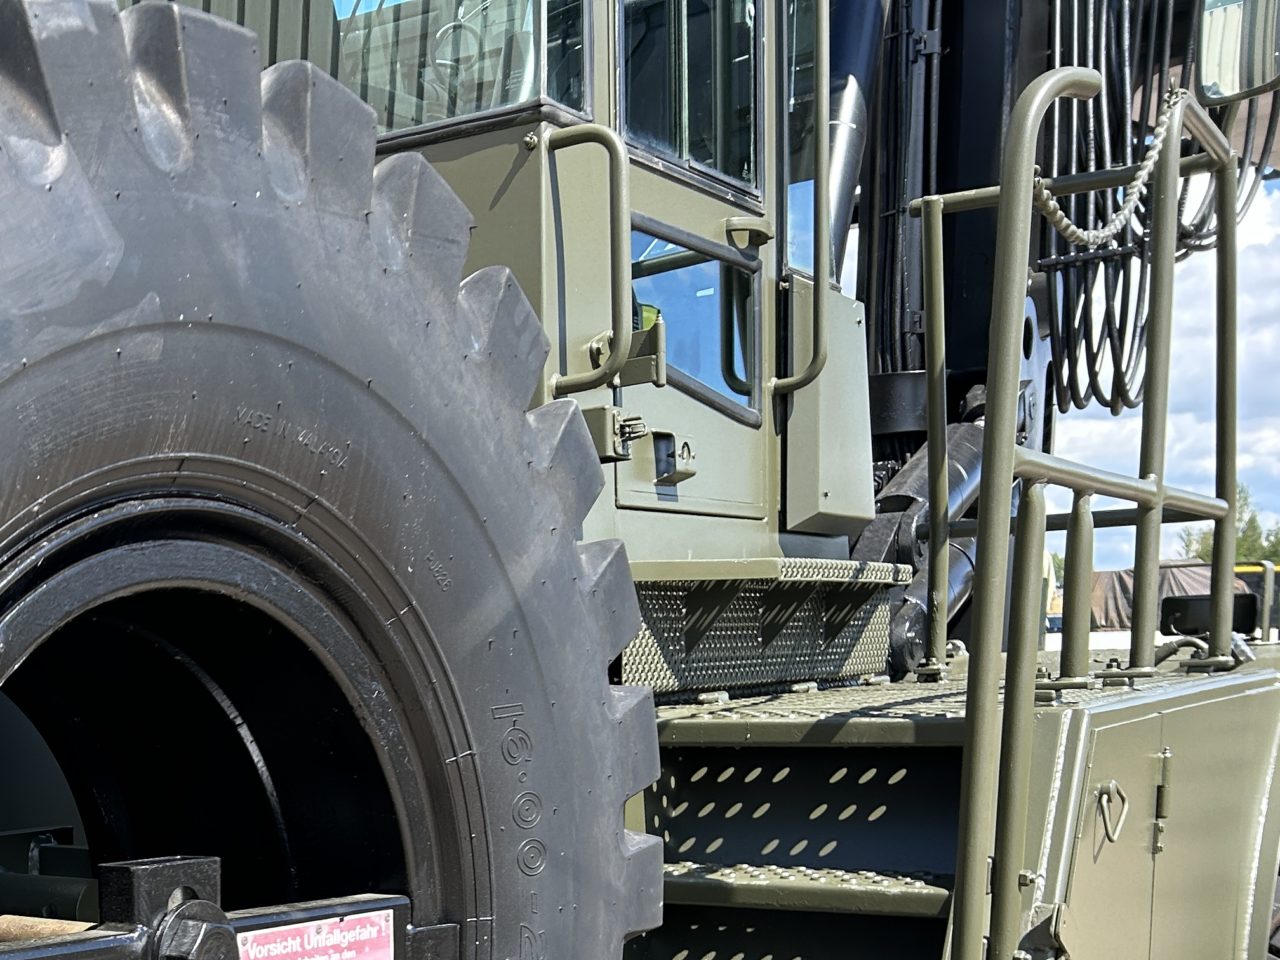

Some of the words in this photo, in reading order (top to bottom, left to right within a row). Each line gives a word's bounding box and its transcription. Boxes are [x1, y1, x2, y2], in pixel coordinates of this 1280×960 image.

[247, 936, 302, 960] Vorsicht
[304, 924, 378, 950] Unfallgefahr
[330, 951, 340, 960] an
[342, 949, 356, 960] den
